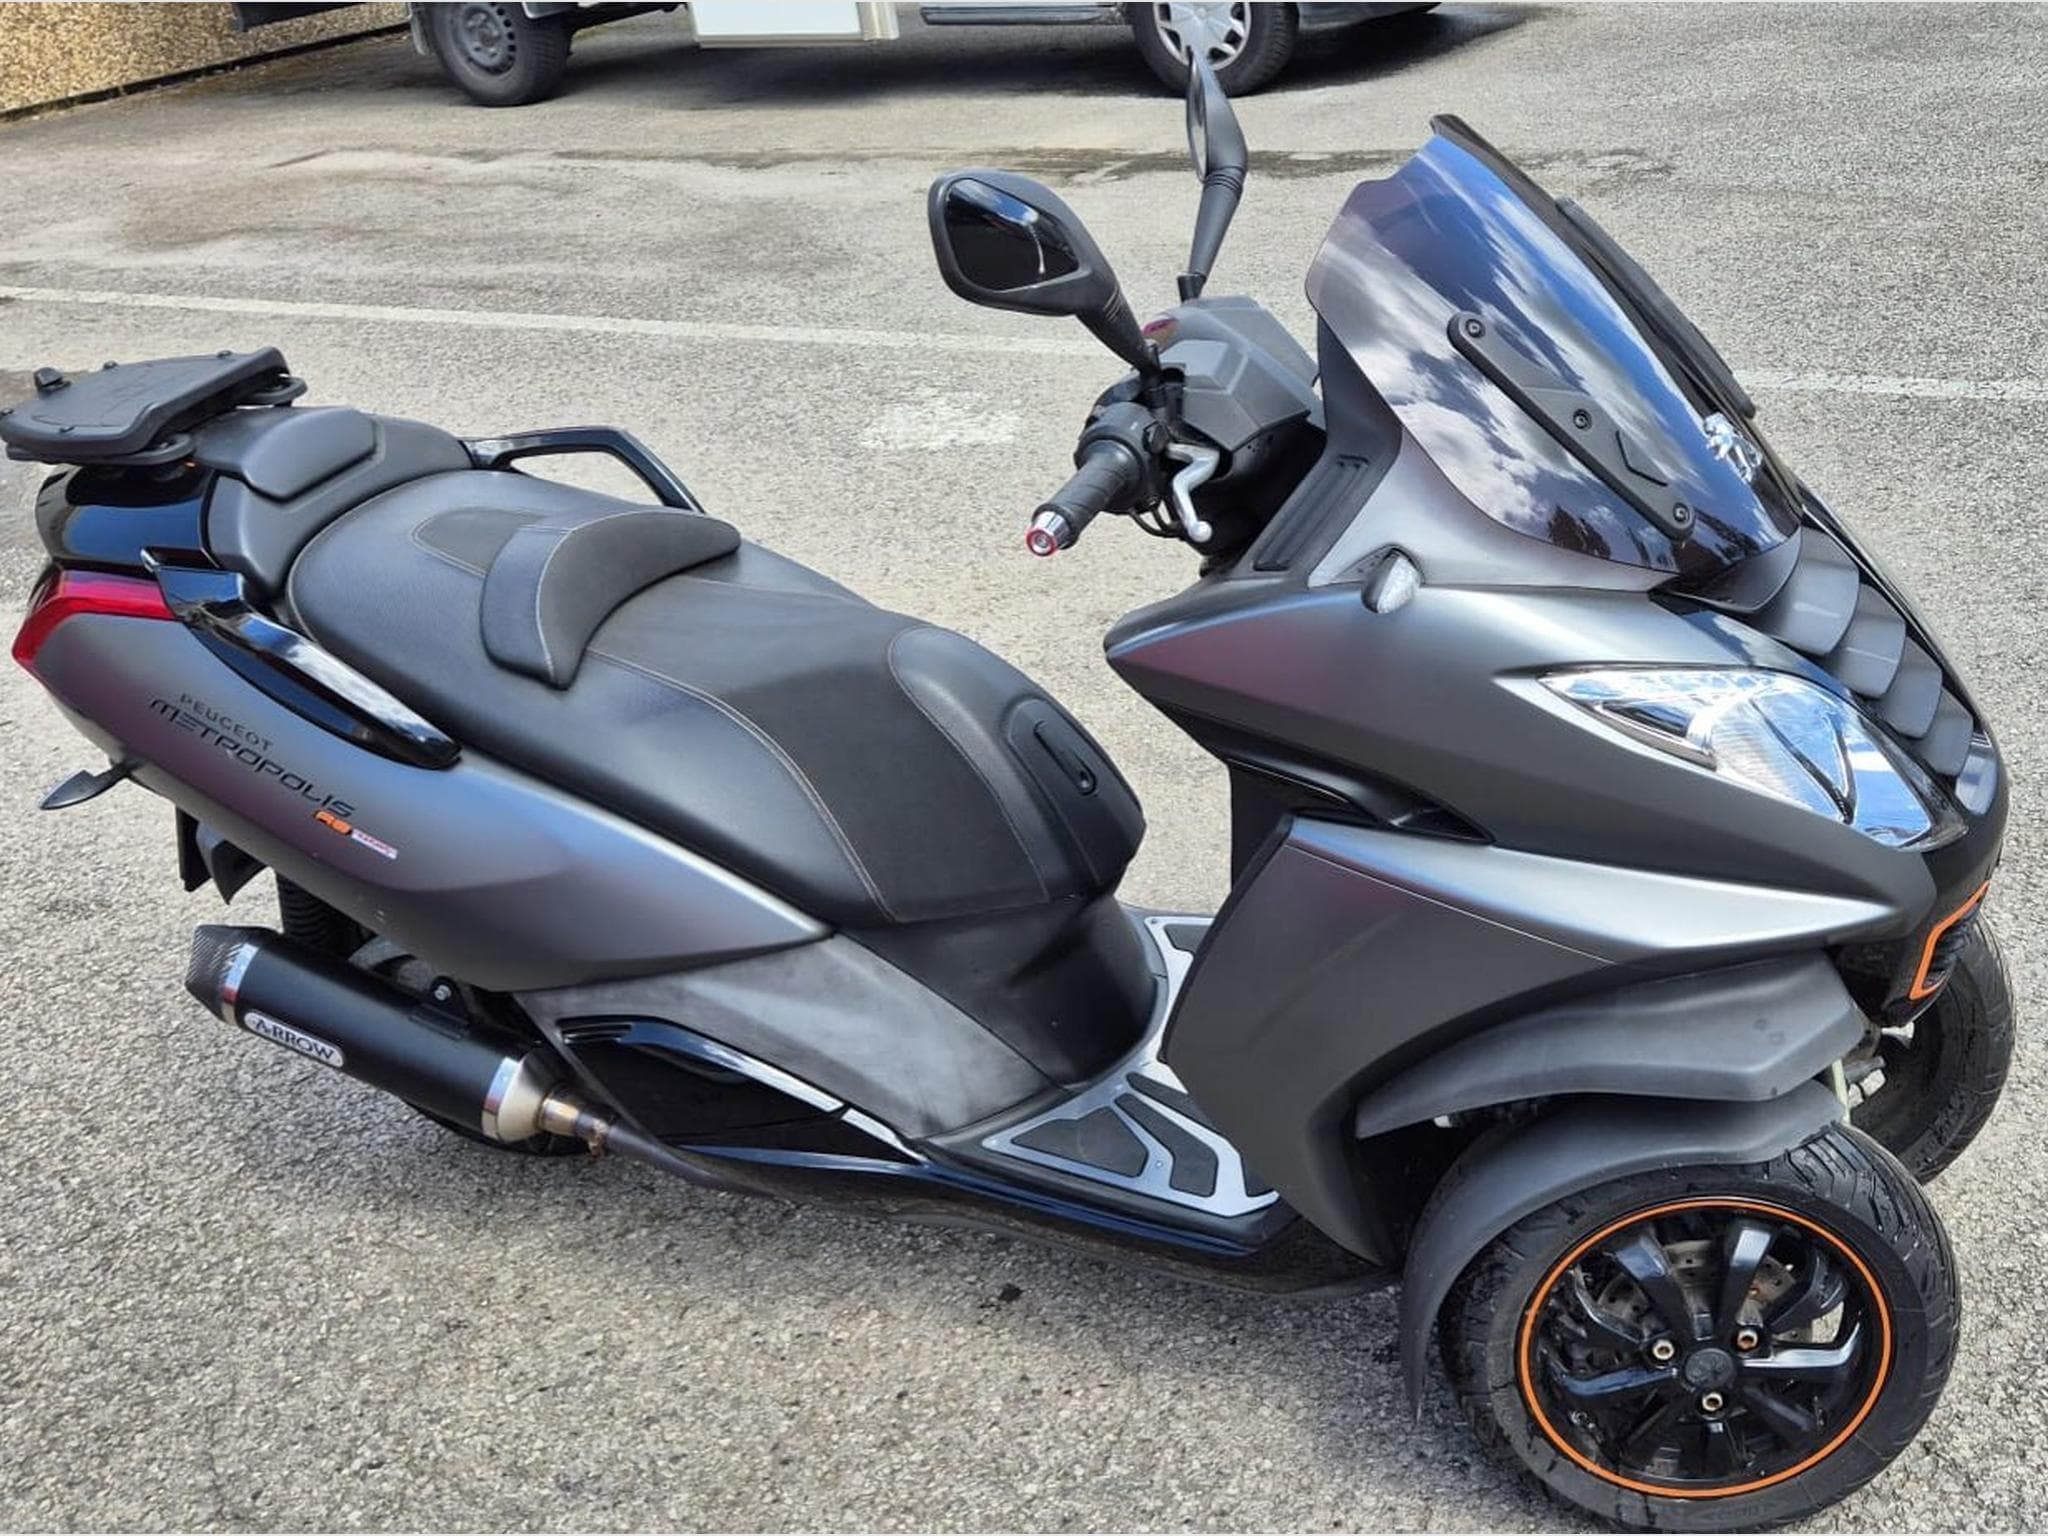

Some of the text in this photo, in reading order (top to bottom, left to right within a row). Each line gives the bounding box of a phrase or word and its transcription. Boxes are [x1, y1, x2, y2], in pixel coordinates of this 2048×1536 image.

[180, 693, 274, 751] PEUGEOT
[149, 699, 356, 817] METROPOLIS
[255, 1019, 335, 1059] ARROW
